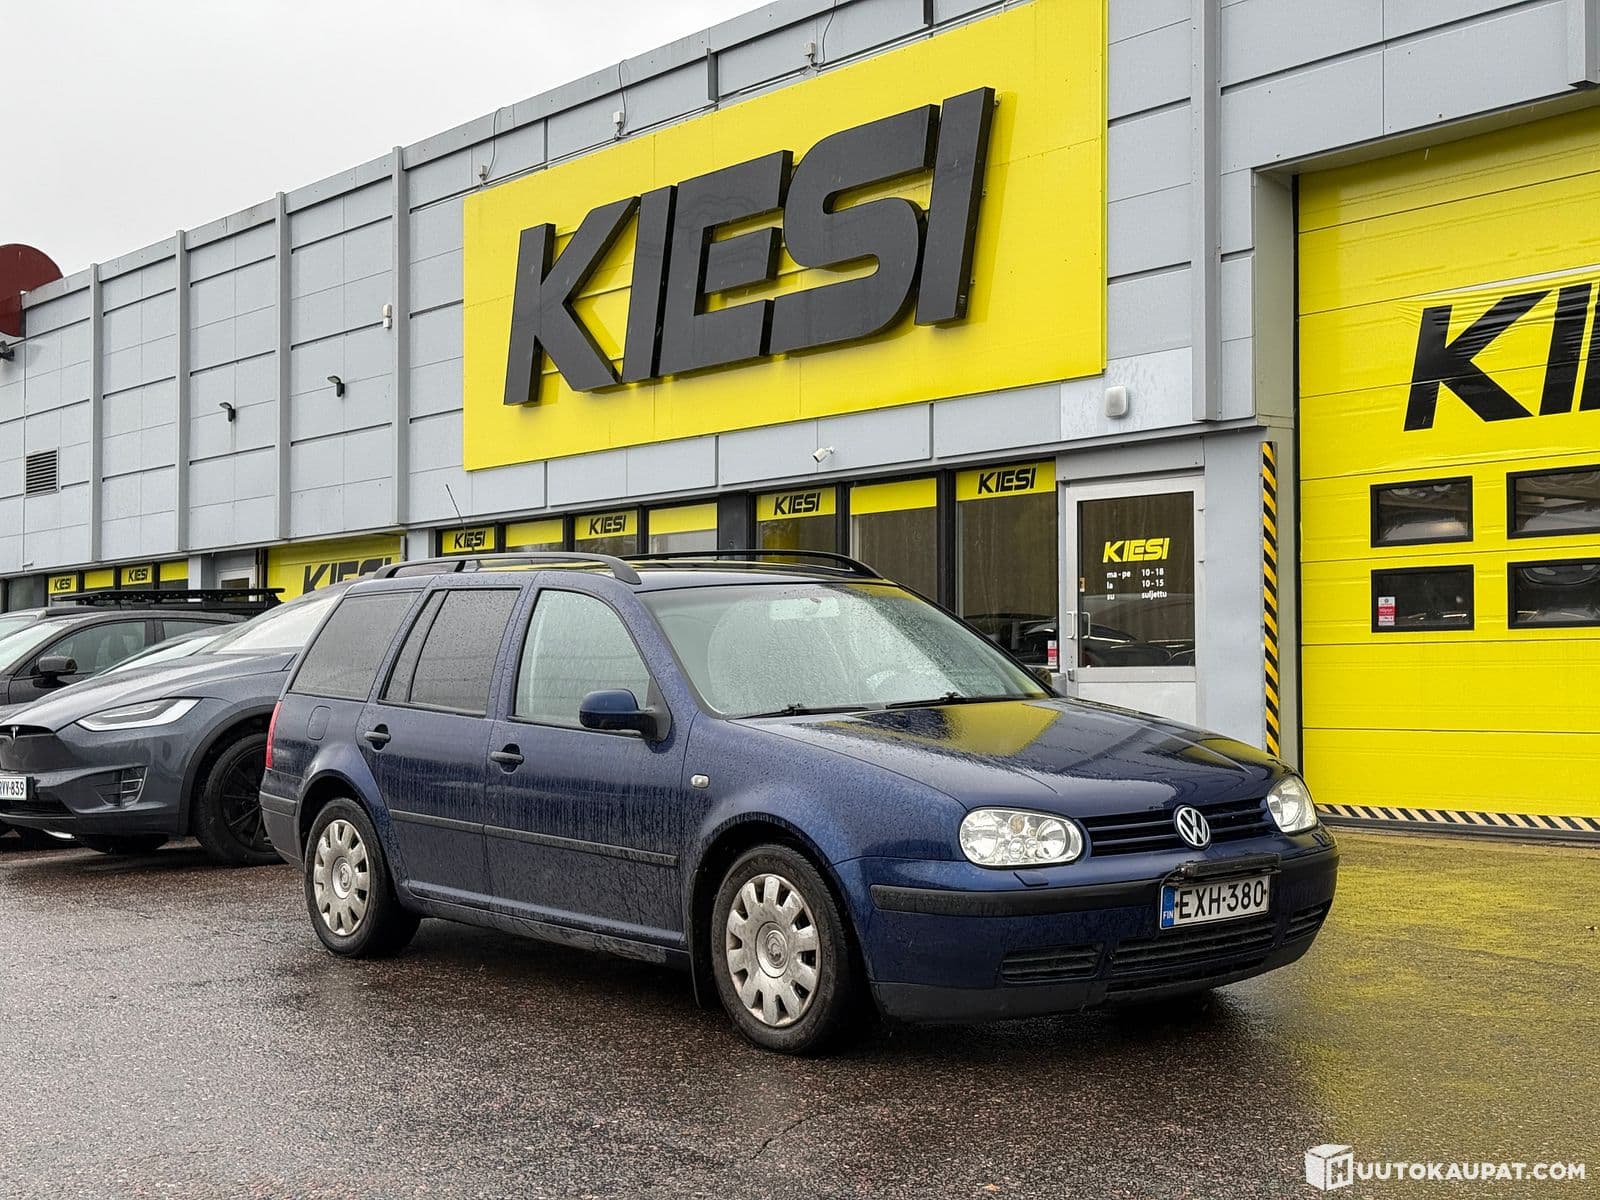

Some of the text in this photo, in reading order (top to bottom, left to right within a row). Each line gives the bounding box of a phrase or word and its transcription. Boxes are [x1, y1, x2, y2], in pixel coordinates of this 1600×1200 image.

[503, 86, 996, 407] KIESI
[977, 468, 1037, 495] KIESI
[773, 492, 821, 516] KIESI
[589, 515, 627, 536] KIESI
[454, 531, 486, 549] KIESI
[1102, 537, 1171, 564] KIESI
[1141, 590, 1168, 601] suljettu
[1179, 881, 1264, 919] EXH-380
[1163, 910, 1174, 920] FIN
